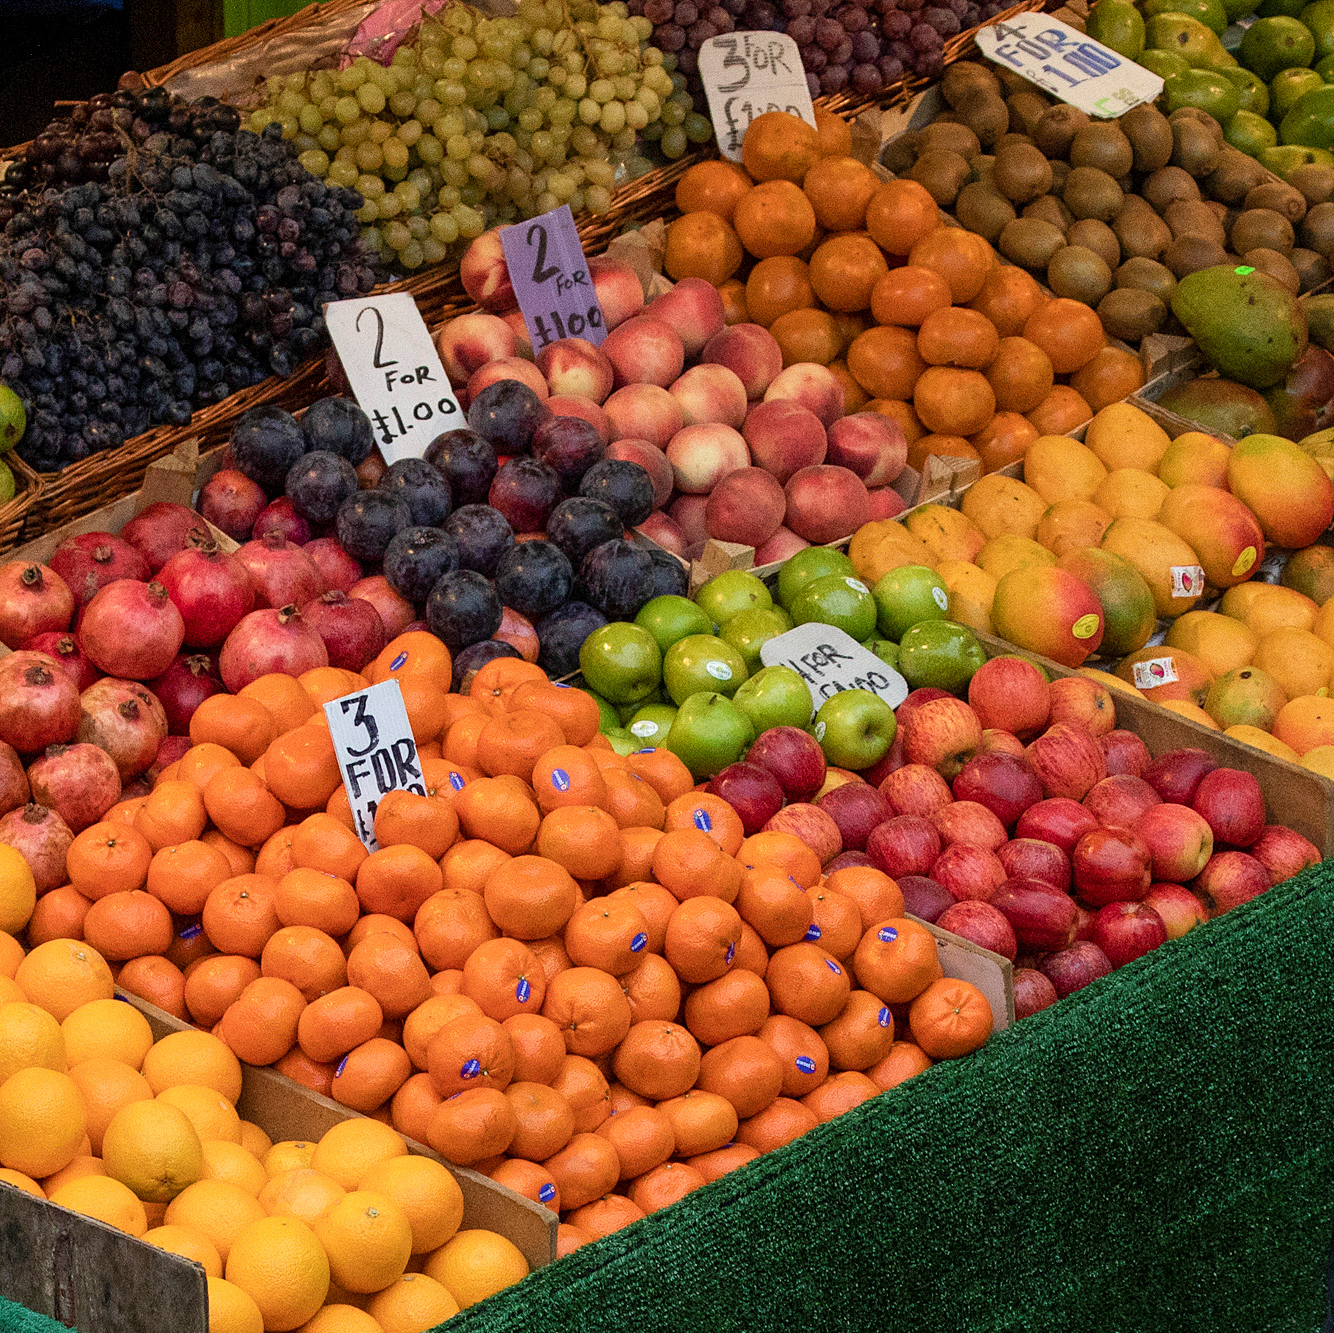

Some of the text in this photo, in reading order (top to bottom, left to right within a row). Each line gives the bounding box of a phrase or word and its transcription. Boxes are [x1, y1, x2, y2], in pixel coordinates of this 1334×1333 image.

[713, 38, 751, 93] 3
[744, 36, 792, 75] FOR
[995, 28, 1079, 68] FOR
[527, 224, 560, 284] 2
[356, 306, 398, 368] 2
[371, 398, 457, 445] £1.00
[801, 644, 855, 677] FOR
[340, 695, 380, 757] 3
[346, 738, 421, 800] FOR
